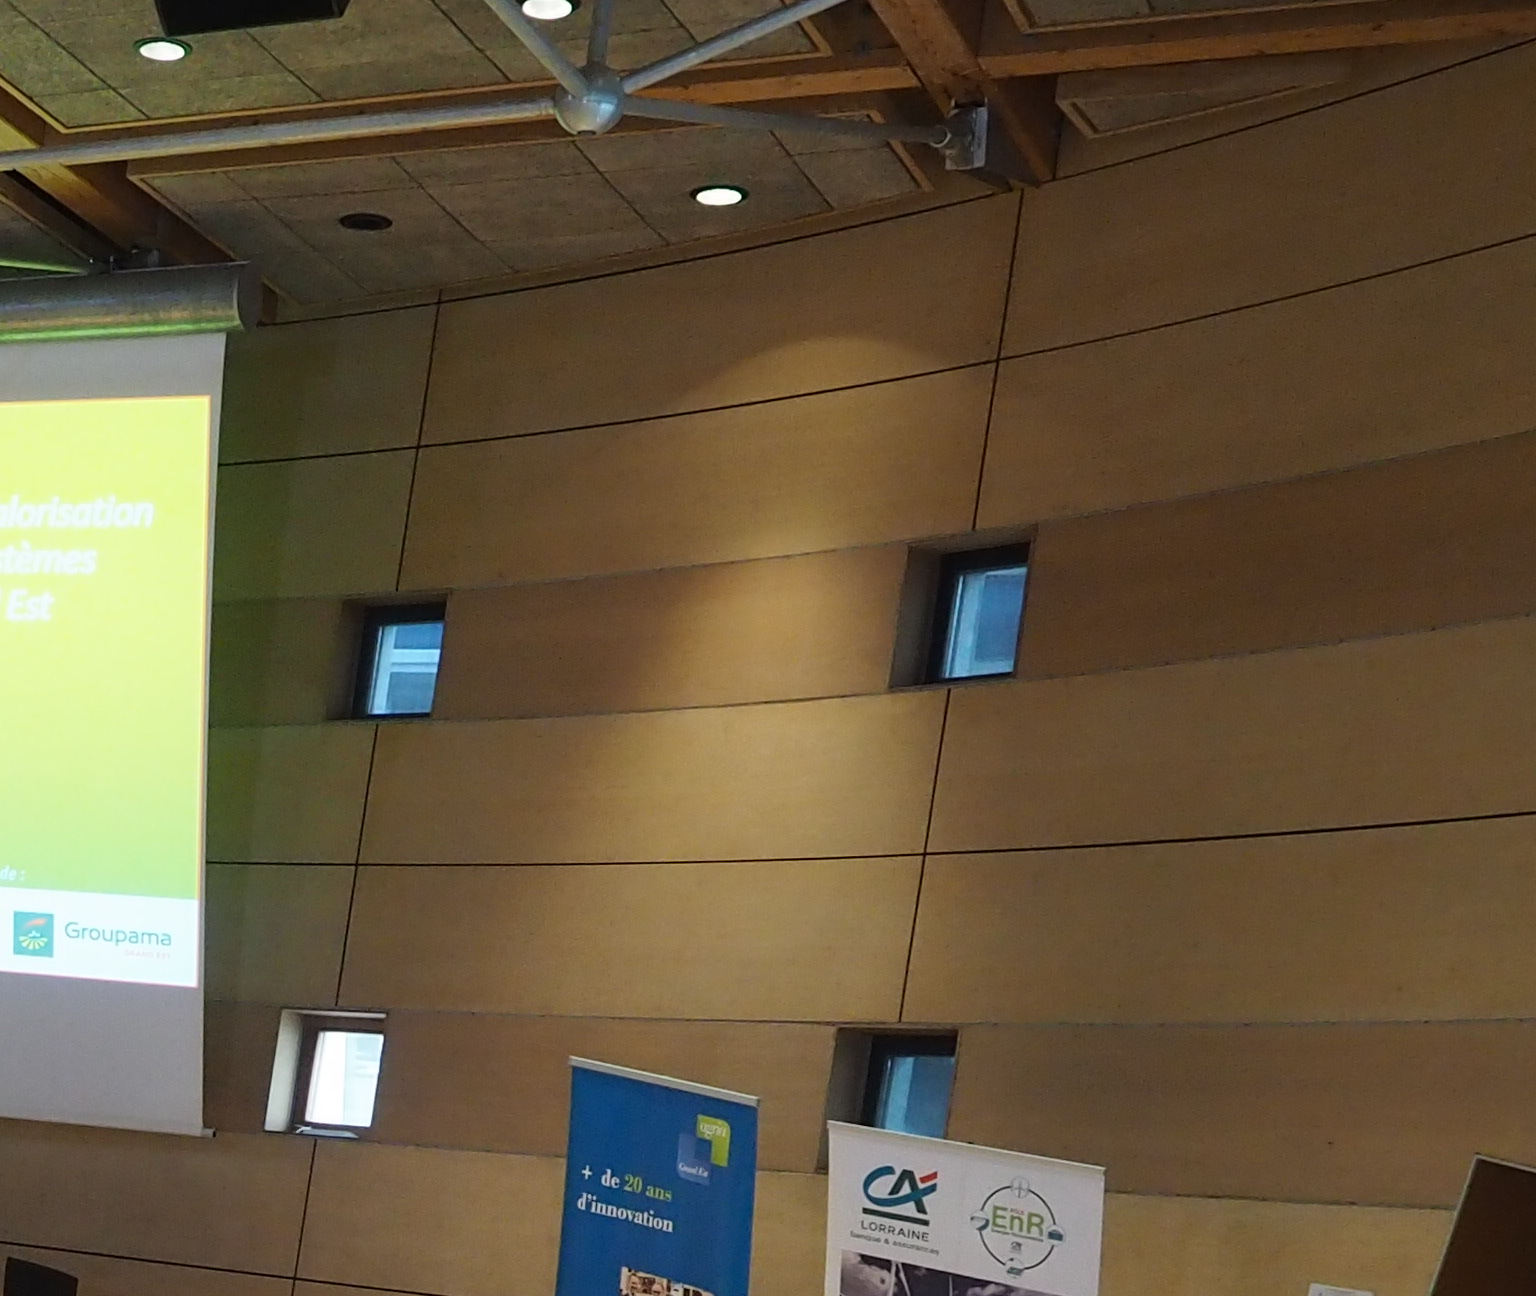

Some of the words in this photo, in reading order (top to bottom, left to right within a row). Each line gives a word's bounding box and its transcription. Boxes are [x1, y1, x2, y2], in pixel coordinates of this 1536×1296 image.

[5, 588, 55, 621] Est
[0, 865, 17, 880] de
[64, 921, 172, 947] Groupama
[601, 1168, 620, 1188] de
[623, 1173, 642, 1194] 20
[646, 1185, 672, 1202] ans
[861, 1220, 930, 1242] LORRAINE
[991, 1206, 1045, 1237] EnR
